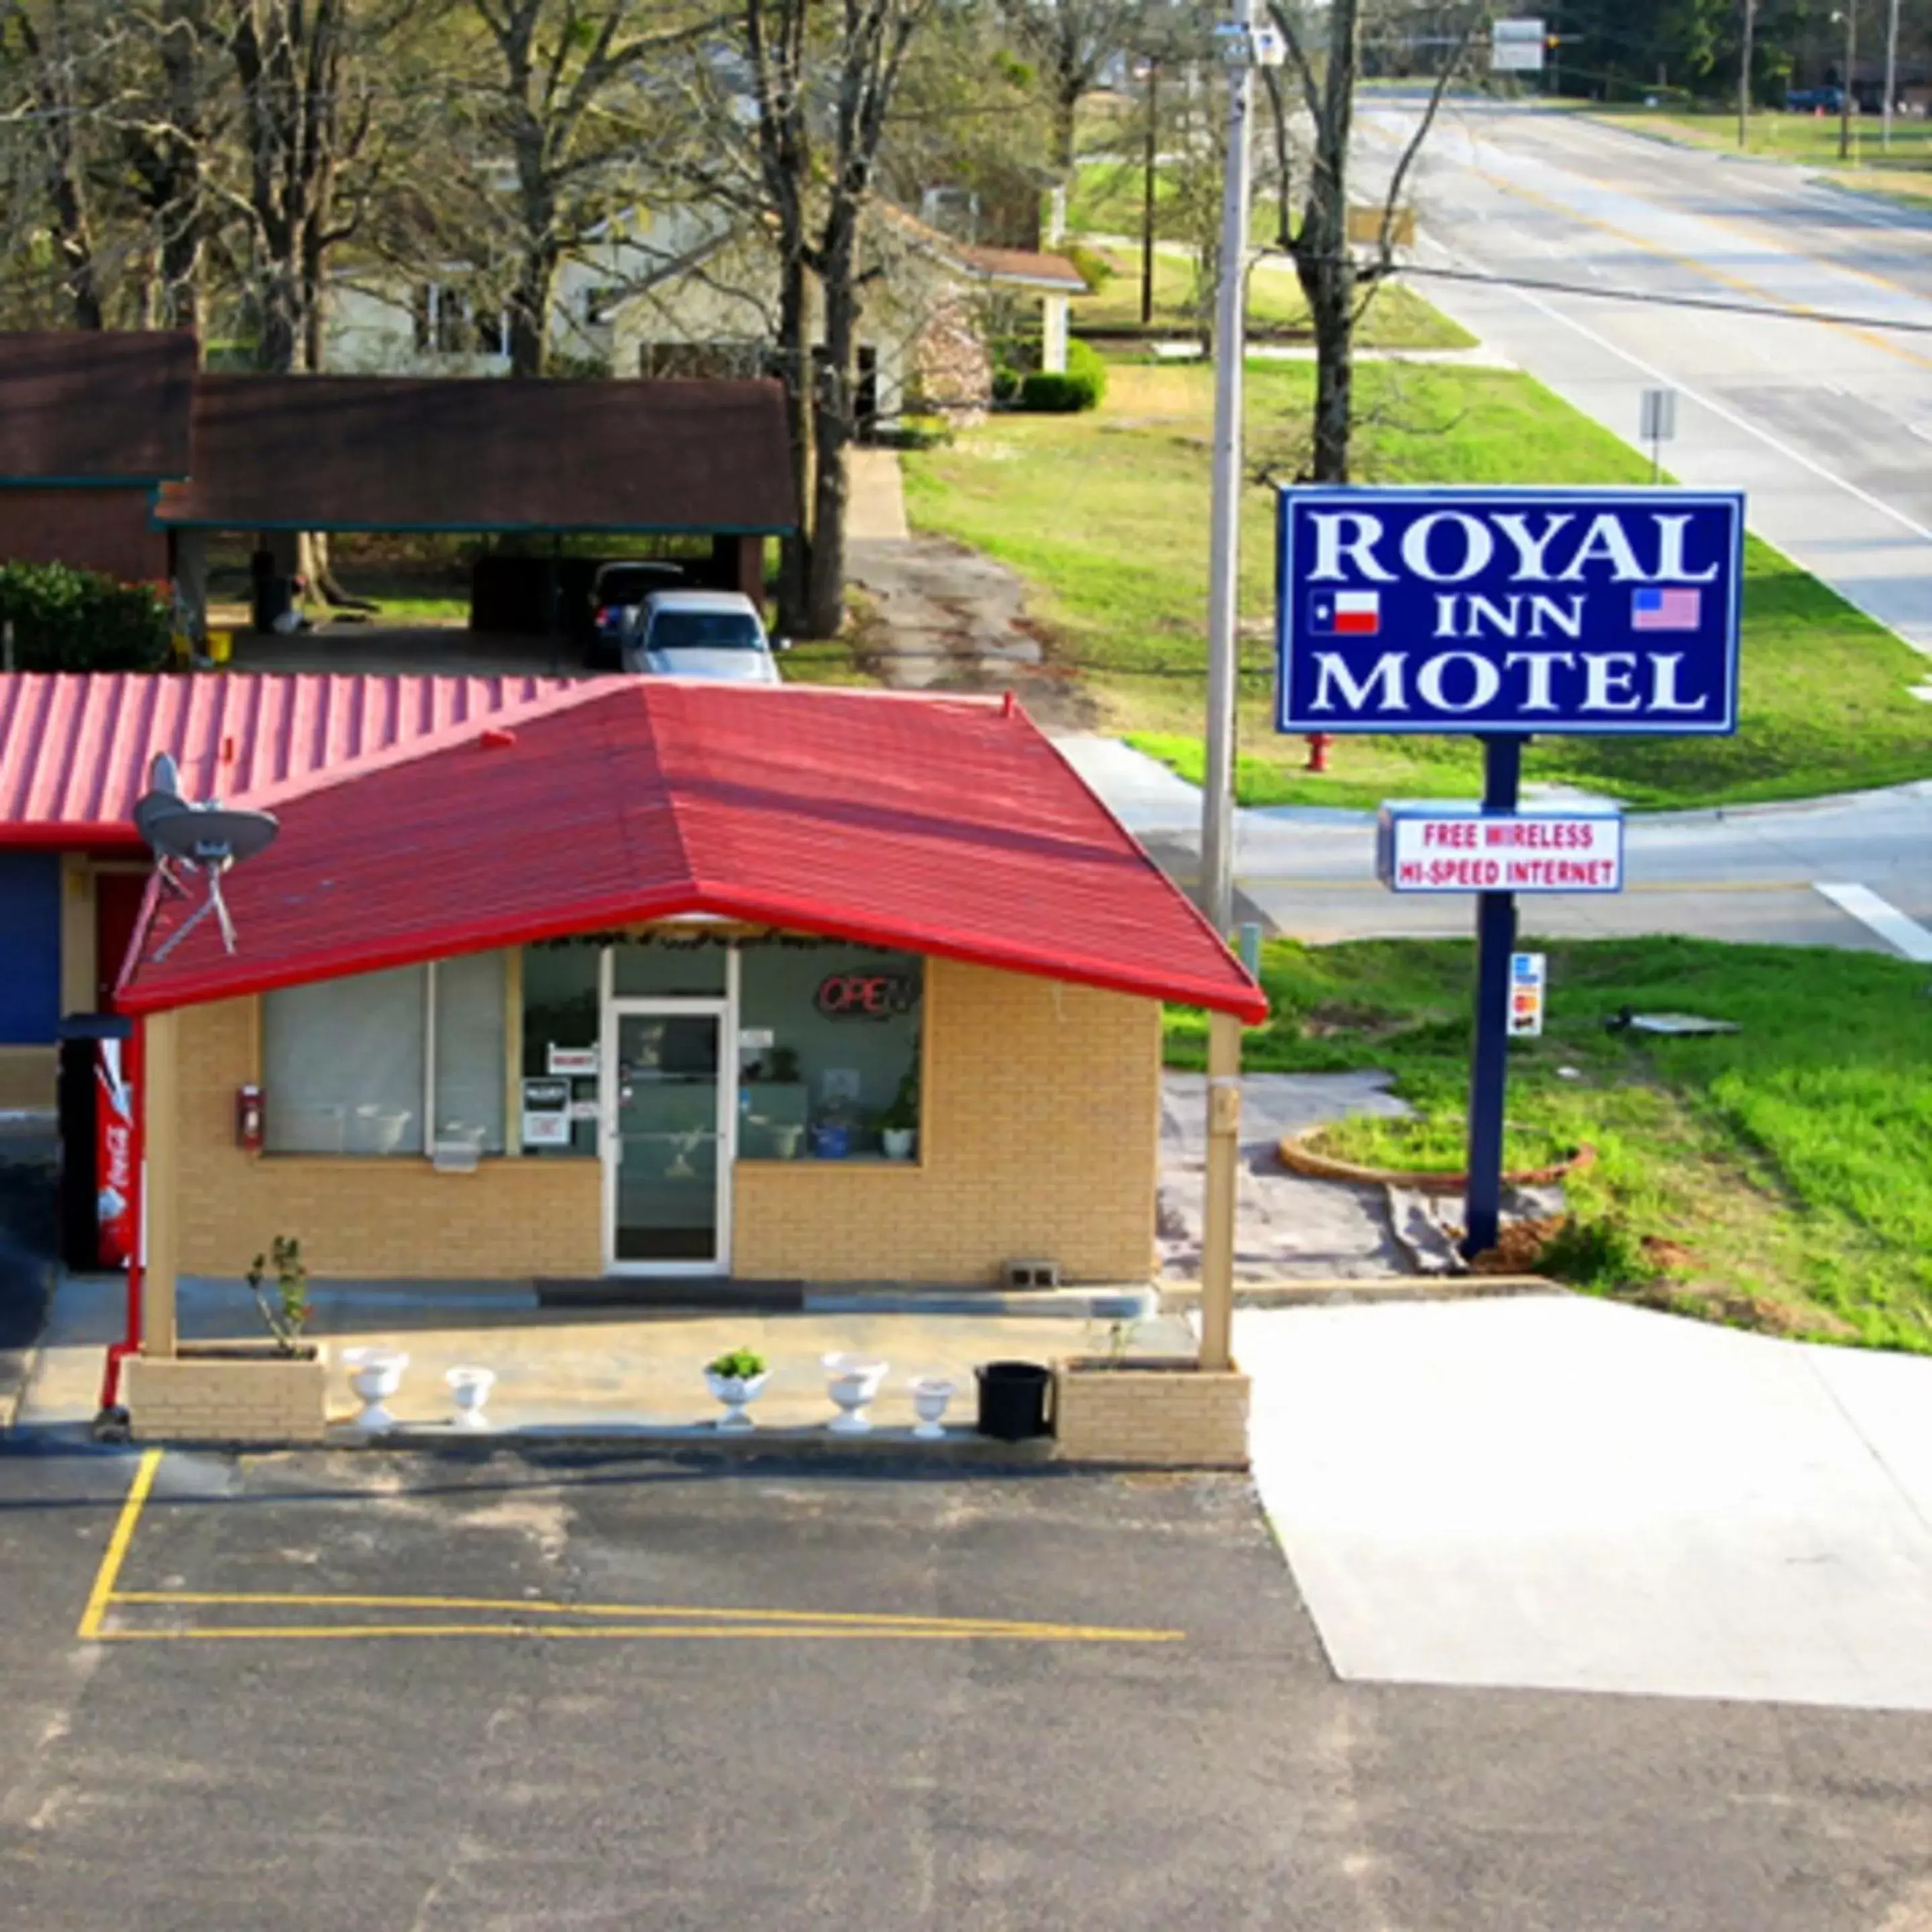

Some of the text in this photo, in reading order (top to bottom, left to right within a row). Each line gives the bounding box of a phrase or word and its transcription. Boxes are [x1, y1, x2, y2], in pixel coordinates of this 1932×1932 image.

[1307, 511, 1719, 582] ROYAL
[1433, 594, 1585, 637] INN
[1309, 651, 1707, 711] MOTEL
[1423, 823, 1477, 847] FREE
[1506, 859, 1613, 884] INTERNET
[819, 975, 912, 1012] OPEN
